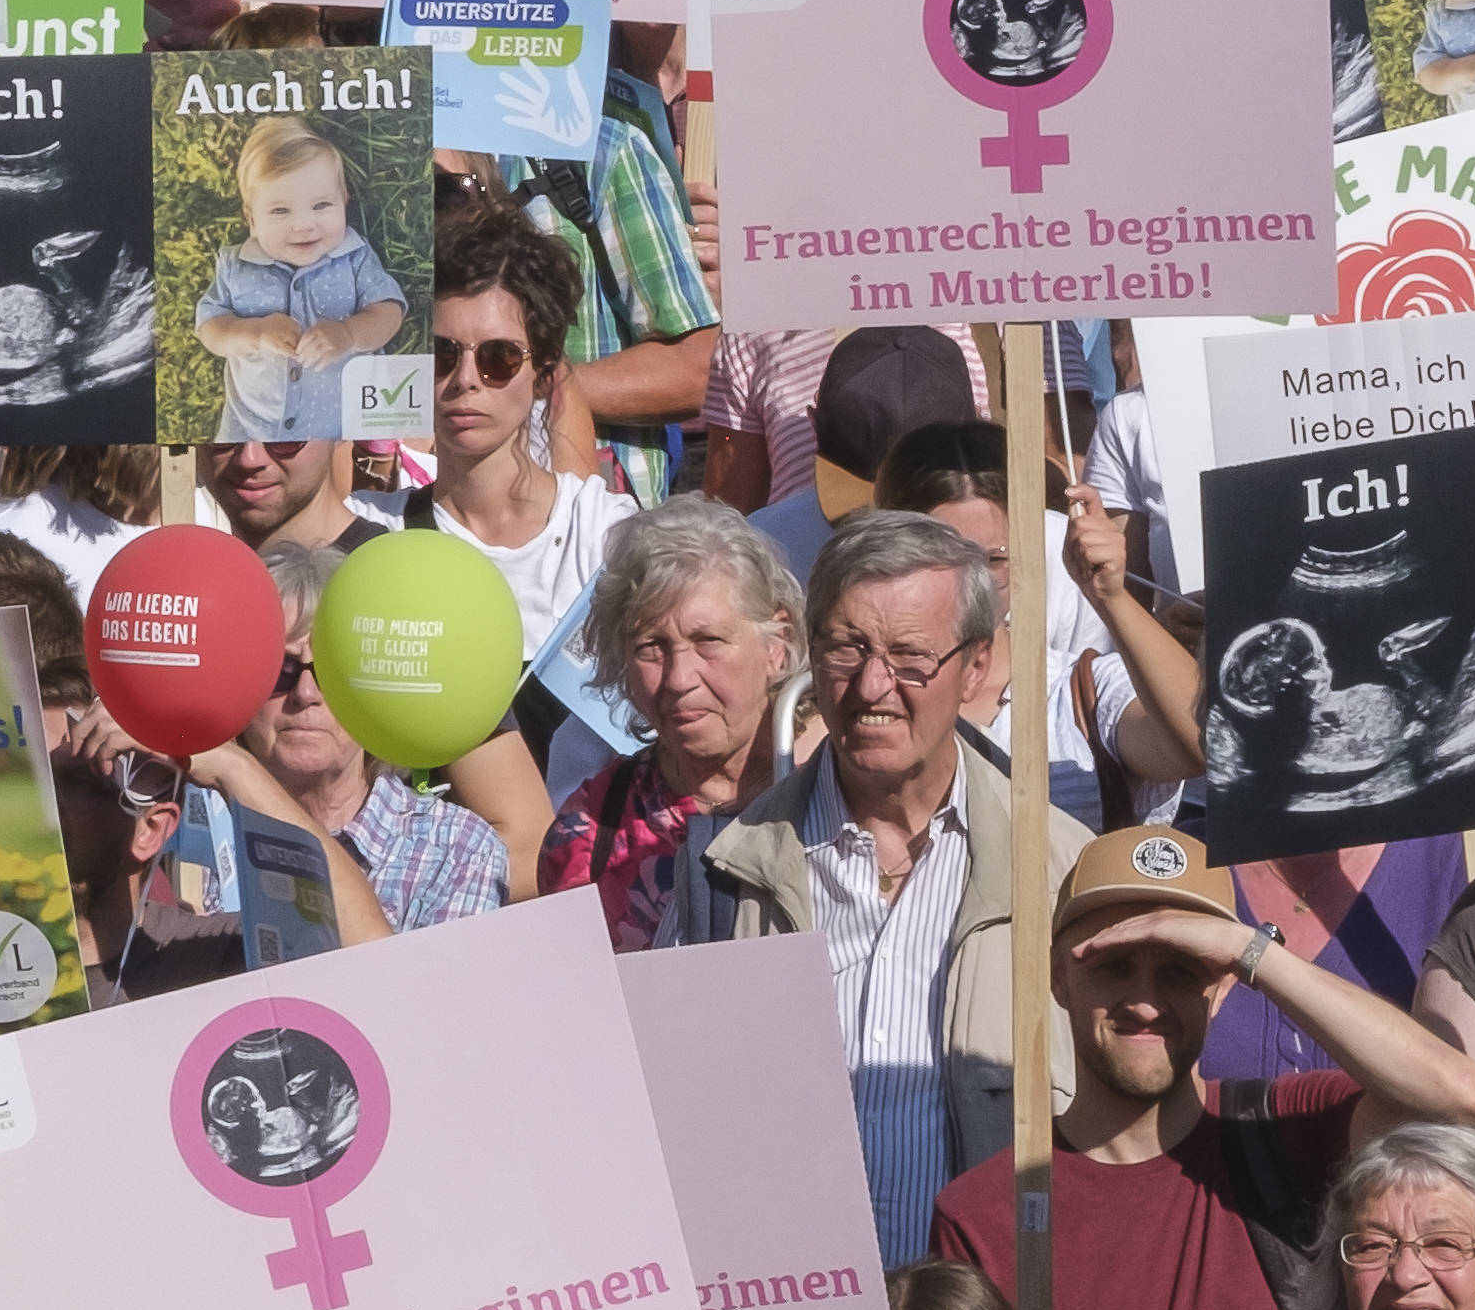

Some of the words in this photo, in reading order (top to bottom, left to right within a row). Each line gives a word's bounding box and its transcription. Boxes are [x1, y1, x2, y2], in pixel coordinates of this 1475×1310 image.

[482, 32, 564, 59] LEBEN
[1303, 464, 1410, 523] Ich!
[105, 591, 131, 612] WIR
[136, 593, 198, 617] LIEBEN
[102, 619, 129, 641] DAS
[134, 620, 198, 645] LEBEN!
